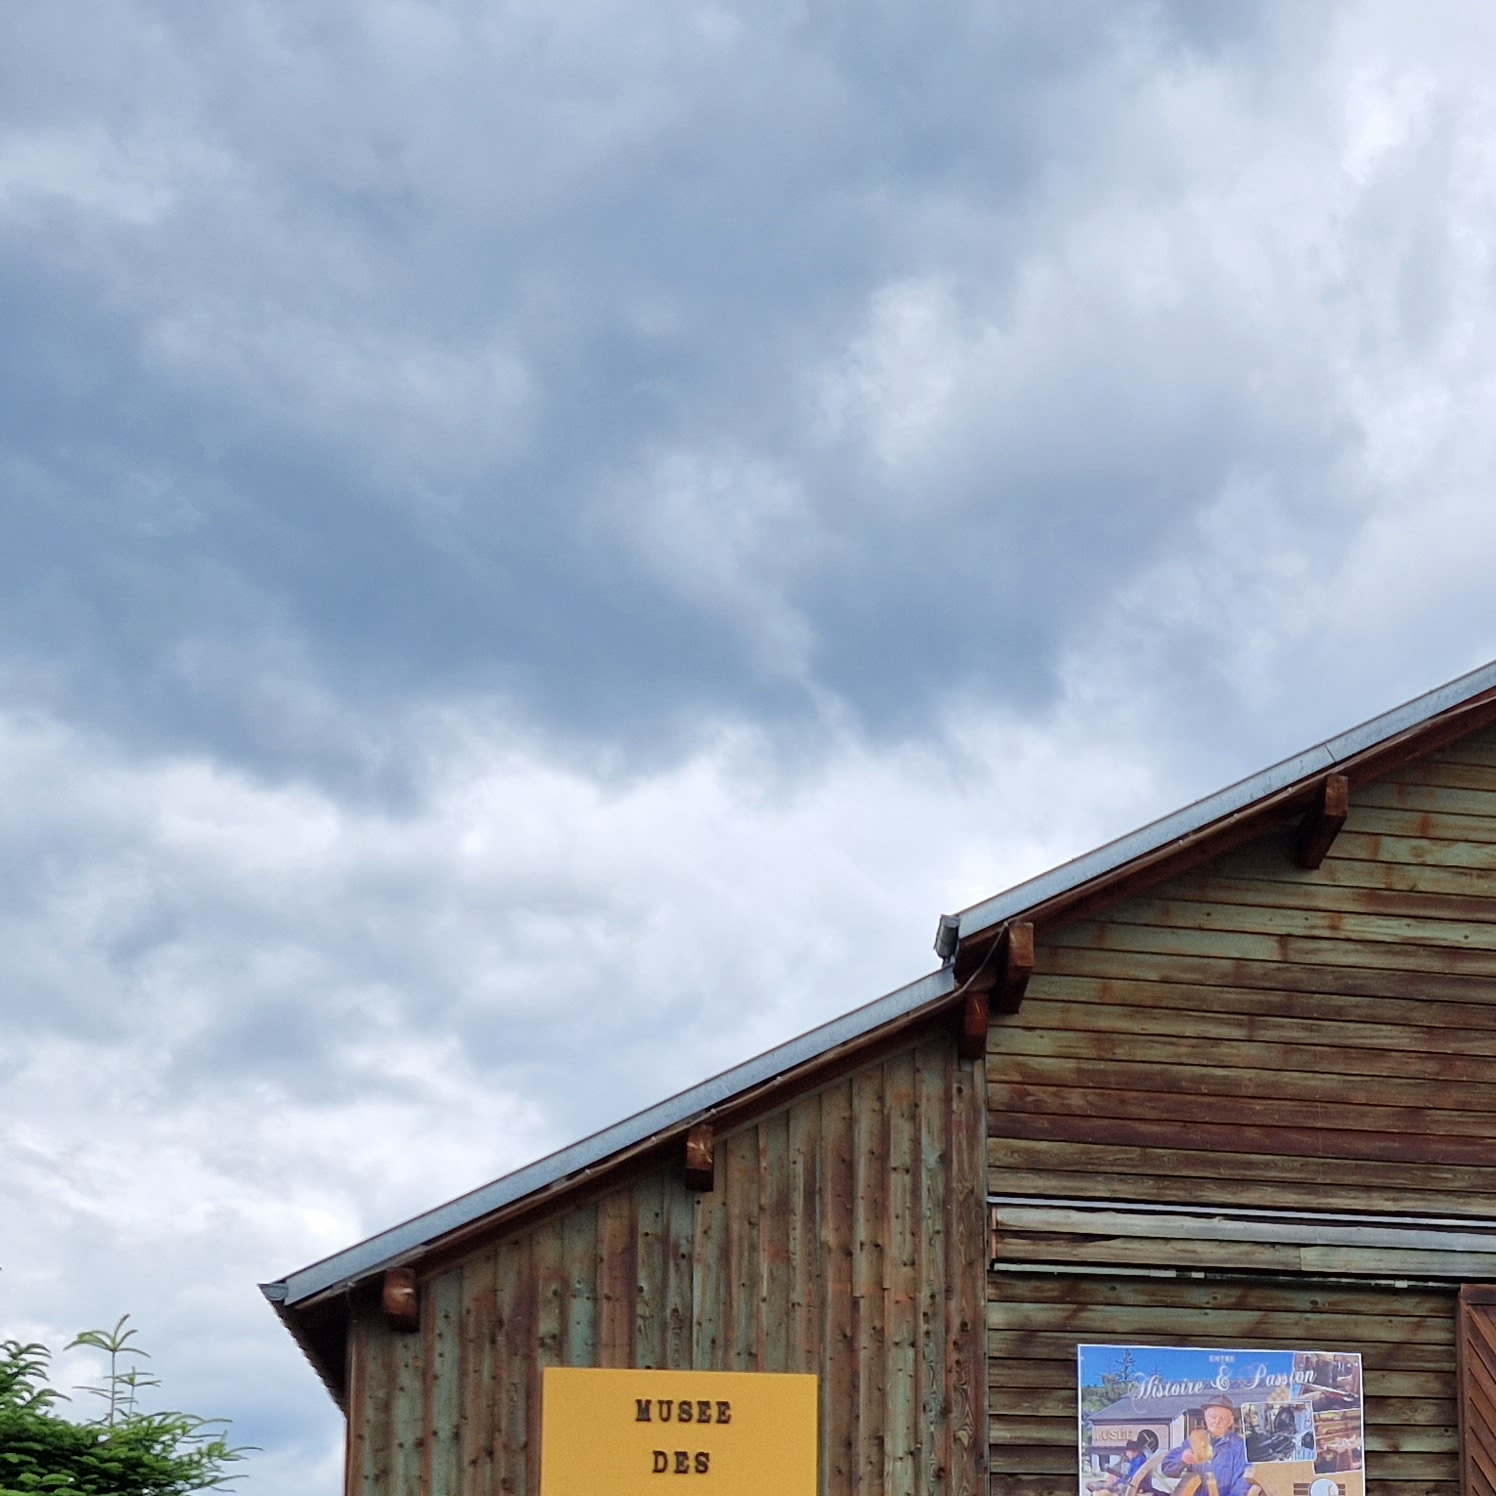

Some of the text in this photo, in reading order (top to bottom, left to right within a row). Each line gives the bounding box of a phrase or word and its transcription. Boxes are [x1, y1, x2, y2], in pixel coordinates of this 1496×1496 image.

[1129, 1364, 1317, 1410] Histoire & Passion
[635, 1399, 732, 1424] MUSEE
[652, 1450, 711, 1474] DES
